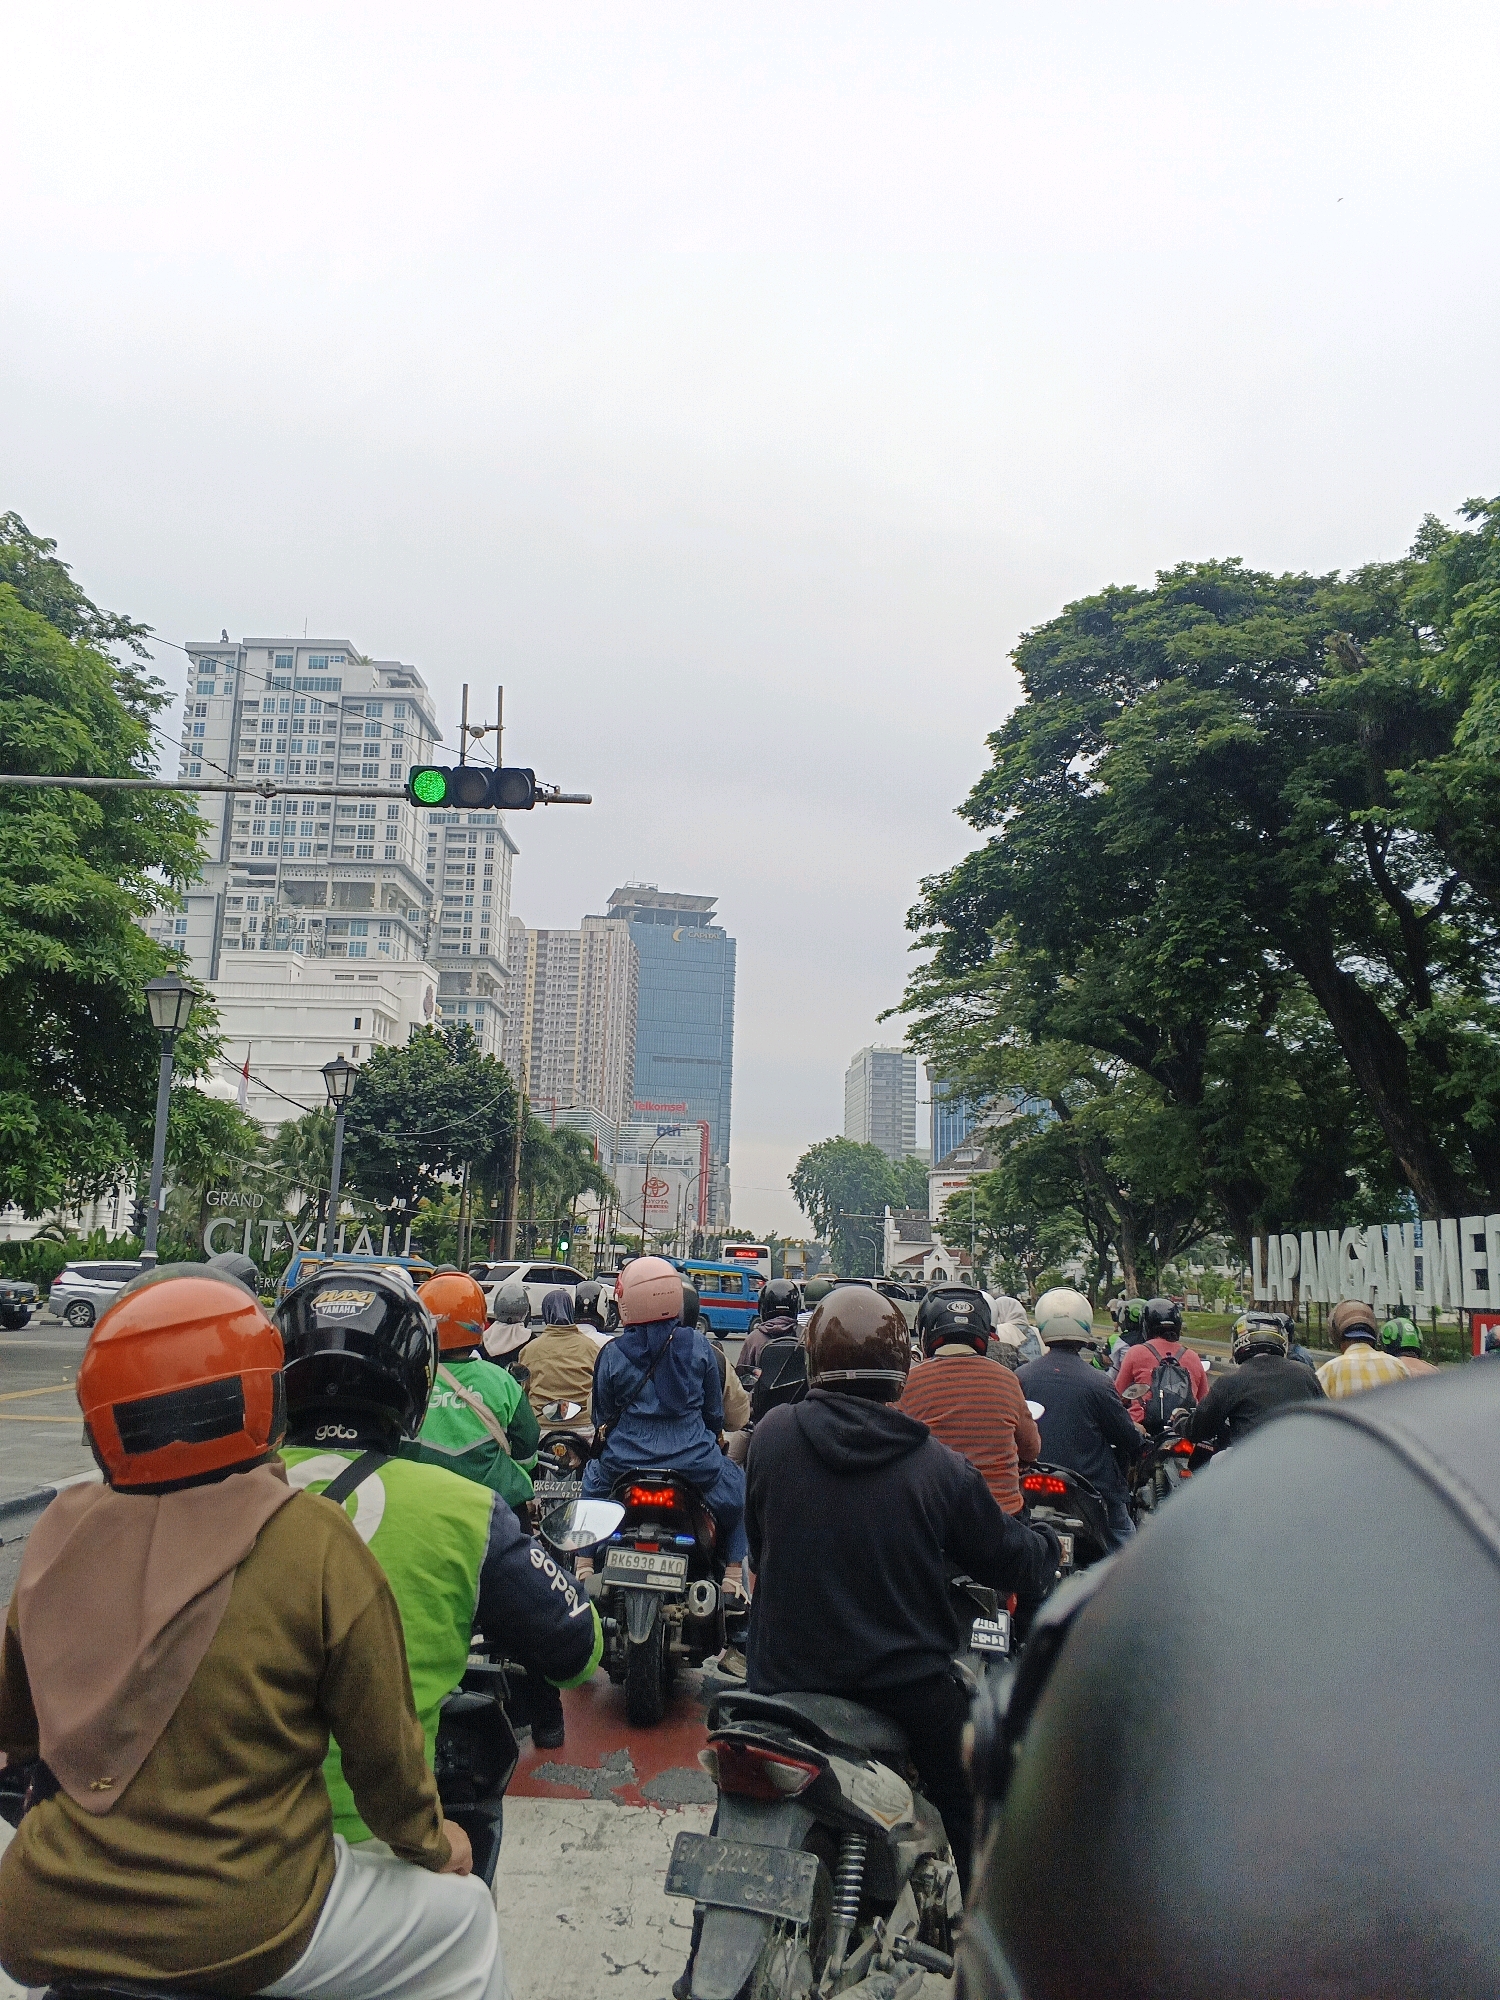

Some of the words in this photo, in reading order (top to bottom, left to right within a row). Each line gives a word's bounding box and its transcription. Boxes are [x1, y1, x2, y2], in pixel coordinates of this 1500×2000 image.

[688, 931, 721, 940] CAPITAL
[633, 1101, 687, 1112] Telkomsel
[206, 1190, 264, 1209] GRAND
[1252, 1225, 1416, 1306] LAPANGAN
[321, 1305, 357, 1314] YAMAHA
[314, 1423, 358, 1441] goto
[611, 1552, 655, 1570] BK6938
[530, 1548, 590, 1617] gopay
